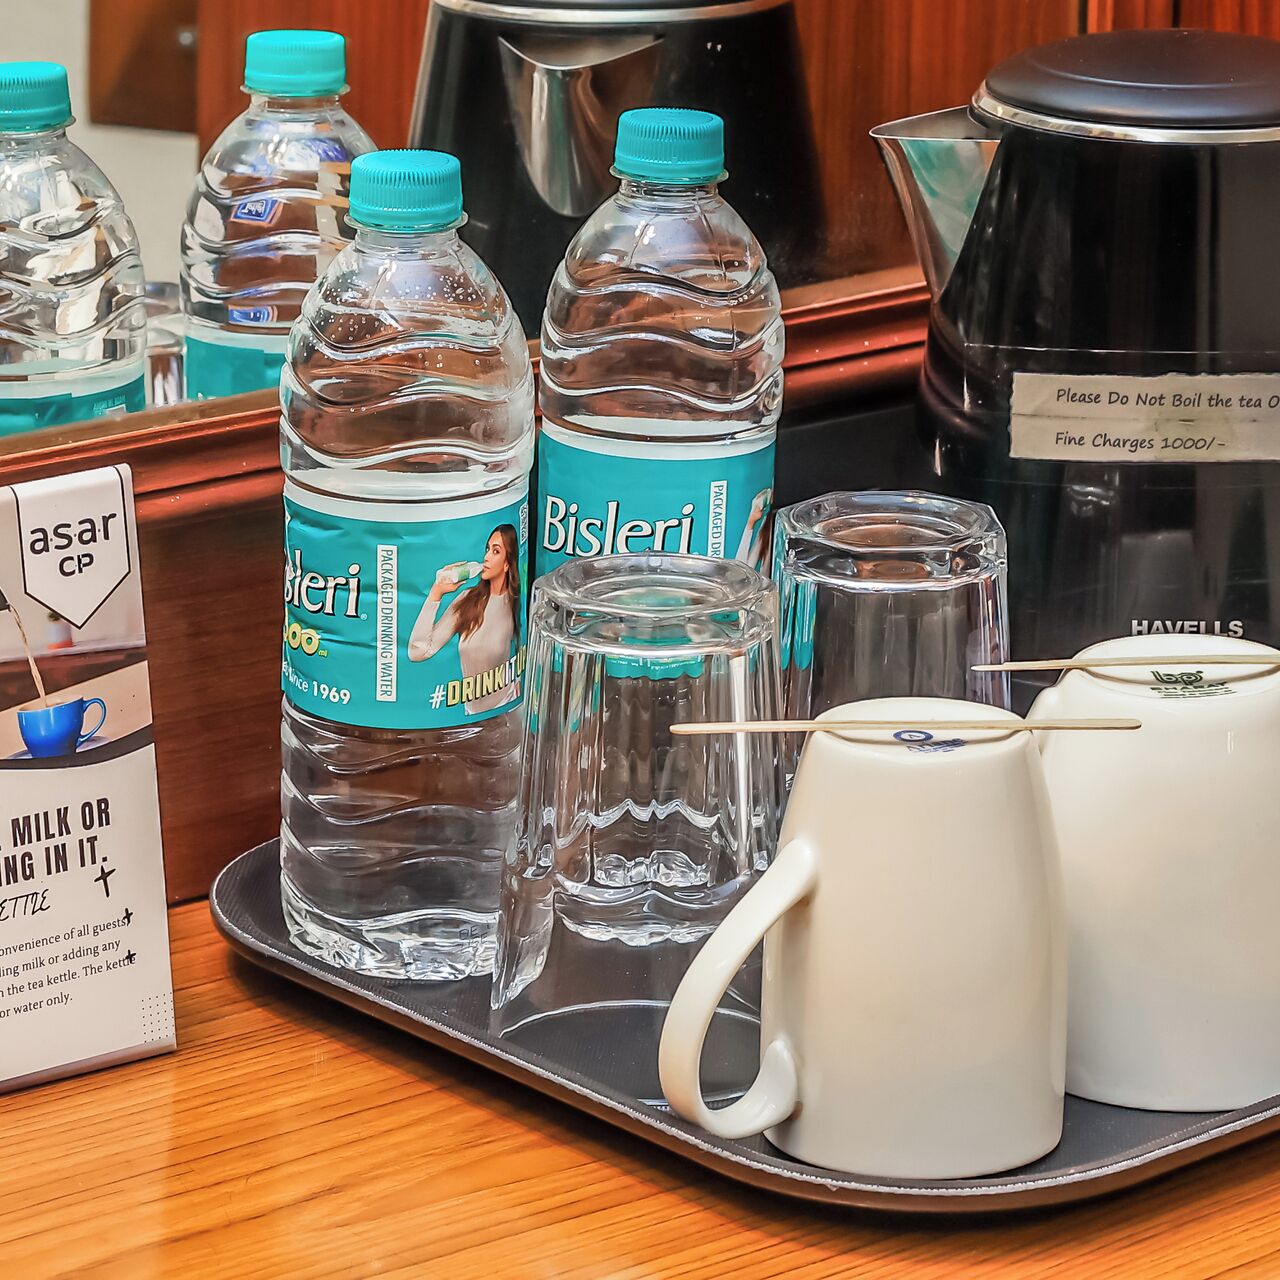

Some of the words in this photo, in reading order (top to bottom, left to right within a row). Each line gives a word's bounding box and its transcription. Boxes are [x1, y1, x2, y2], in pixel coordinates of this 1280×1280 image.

[1056, 388, 1102, 404] Please
[1108, 391, 1129, 406] Do
[1136, 393, 1166, 406] Not
[1172, 393, 1201, 408] Boil
[1207, 394, 1233, 408] the
[1238, 396, 1262, 408] tea
[1055, 432, 1085, 446] Fine
[1092, 434, 1154, 452] Charges
[1160, 436, 1226, 450] 1000/-
[543, 495, 695, 556] Bisleri
[712, 484, 724, 539] PACKAGED
[58, 552, 94, 577] CP
[380, 548, 394, 604] PACKAGED
[380, 607, 394, 659] DRINKING
[312, 680, 351, 705] 1969
[380, 662, 394, 696] WATER
[11, 806, 71, 848] MILK
[80, 797, 111, 830] OR
[45, 842, 68, 876] IN
[78, 836, 108, 868] IT.
[64, 928, 76, 940] of
[77, 924, 90, 938] all
[22, 958, 46, 972] milk
[48, 955, 60, 965] or
[62, 946, 100, 962] adding
[102, 940, 121, 952] any
[6, 983, 25, 996] the
[28, 980, 44, 991] tea
[46, 970, 81, 986] kettle.
[82, 963, 103, 977] The
[13, 1000, 44, 1014] water
[46, 992, 73, 1006] only.
